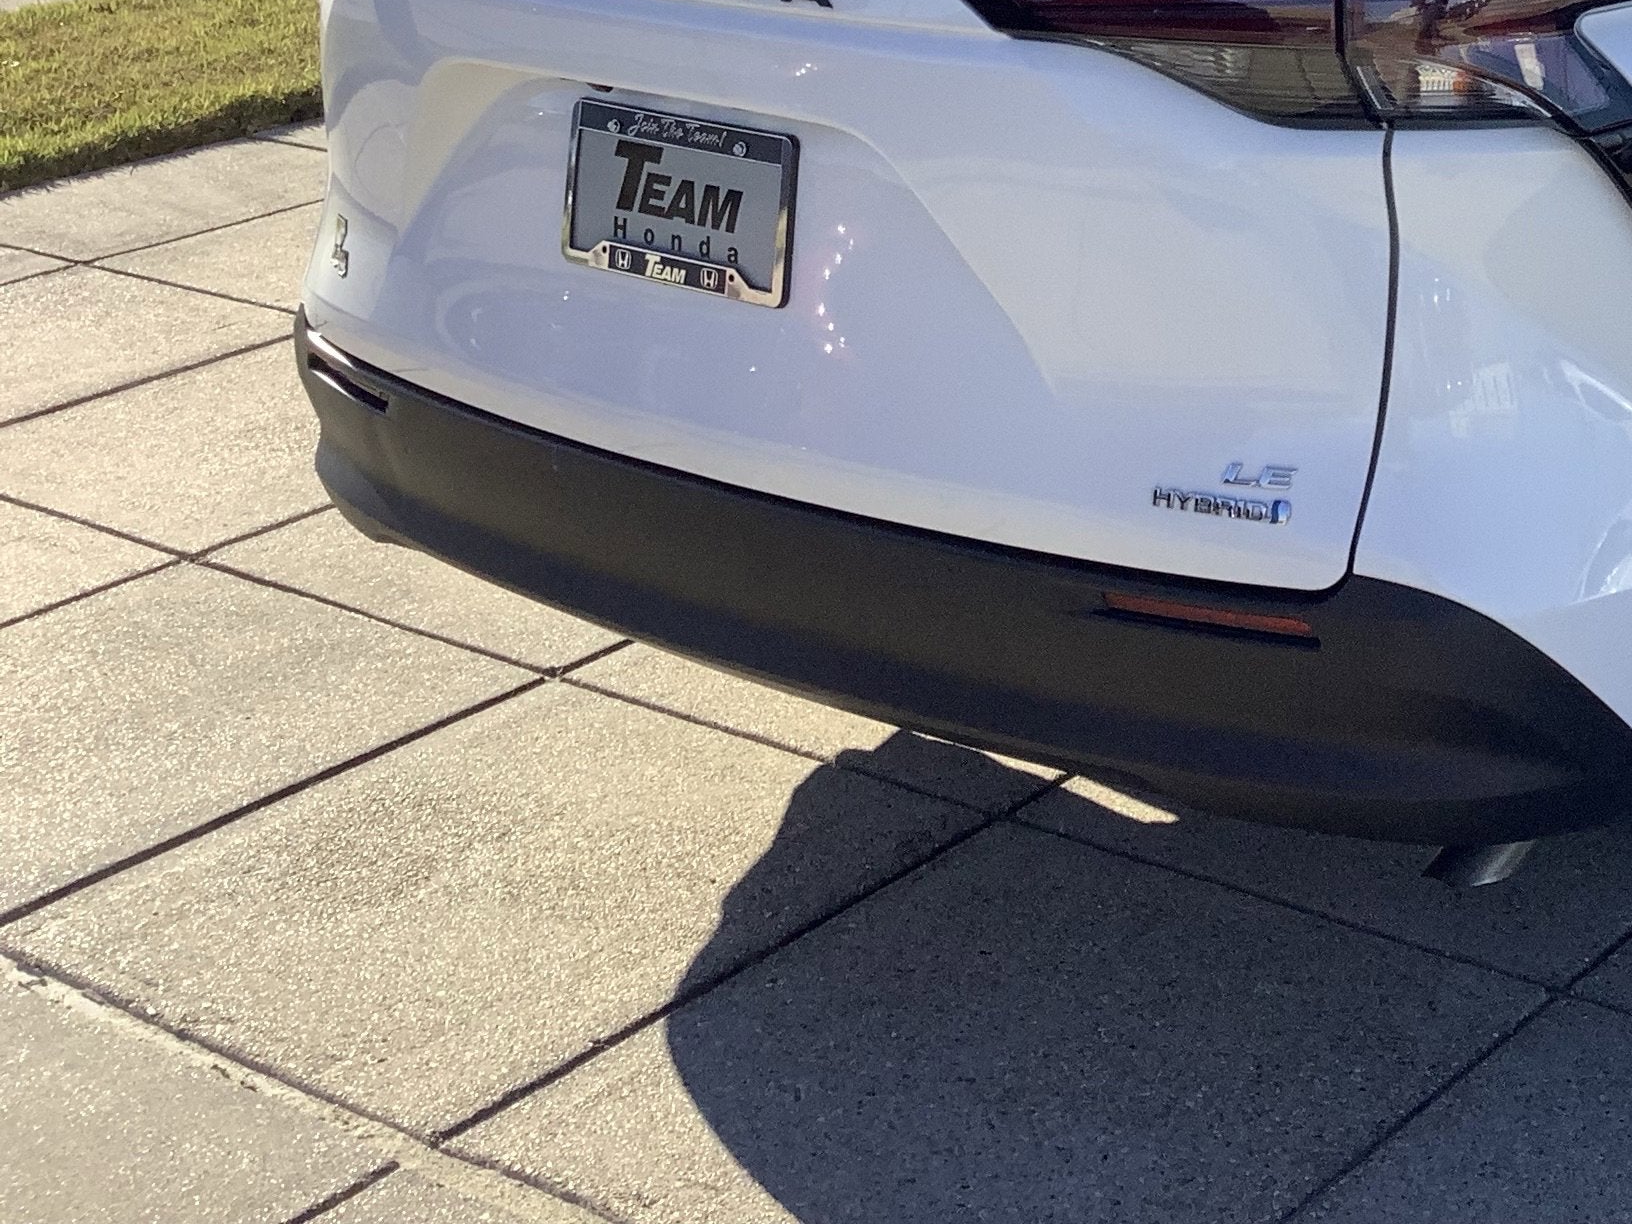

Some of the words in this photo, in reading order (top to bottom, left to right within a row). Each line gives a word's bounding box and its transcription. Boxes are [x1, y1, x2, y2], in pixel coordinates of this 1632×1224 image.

[627, 113, 660, 137] Join
[661, 118, 684, 140] The
[685, 123, 727, 148] Team!
[614, 139, 744, 234] TEAM
[612, 216, 739, 265] Honda
[644, 253, 687, 284] TEAM
[1222, 462, 1299, 490] LE
[1152, 486, 1269, 522] HYBRID
